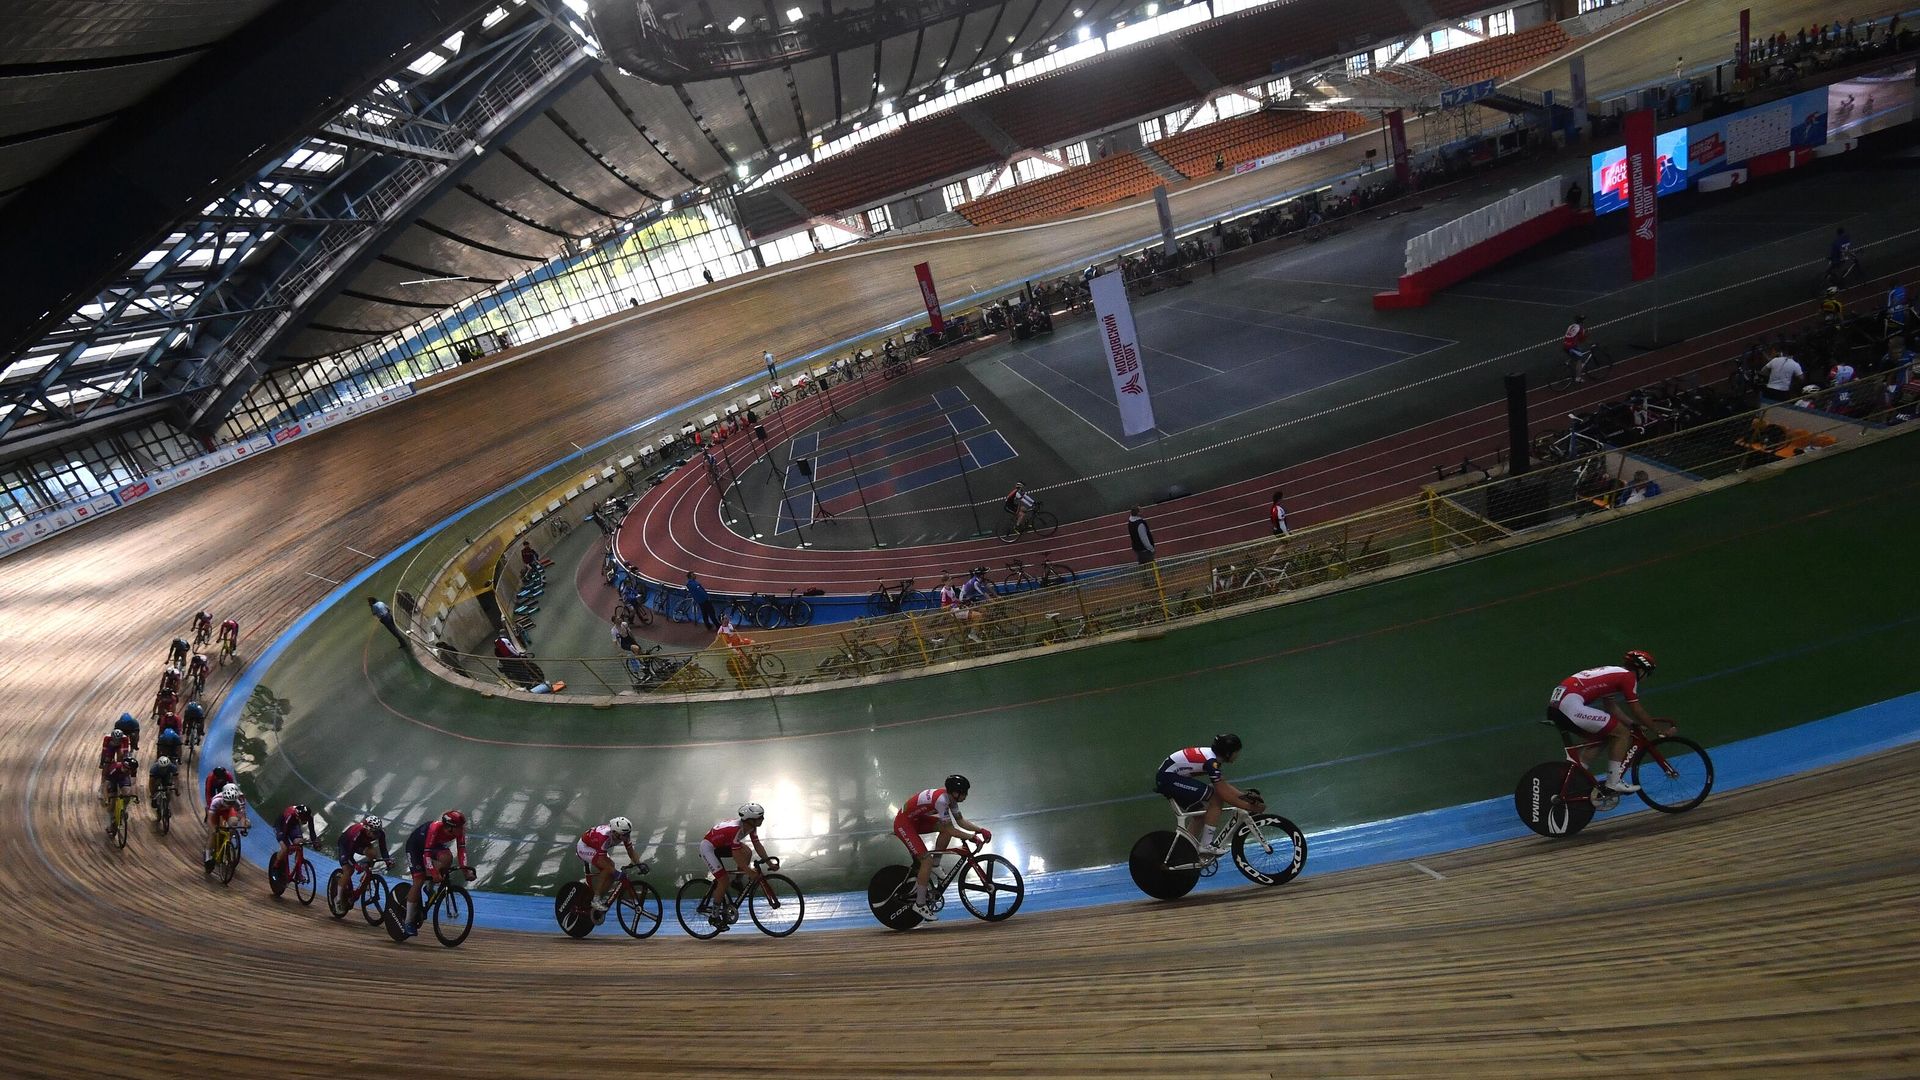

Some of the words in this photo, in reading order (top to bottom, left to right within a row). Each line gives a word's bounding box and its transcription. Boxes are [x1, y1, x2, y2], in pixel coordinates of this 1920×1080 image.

[1789, 150, 1796, 169] 1
[1630, 153, 1644, 218] МОСКОВСКИЙ
[1731, 172, 1740, 188] 2
[1643, 184, 1654, 215] СПОРТ
[1101, 313, 1128, 376] МОСКОВСКИЙ
[1122, 342, 1139, 372] СПОРТ
[1532, 777, 1540, 823] CORIMA
[1213, 814, 1239, 849] RIDLEY
[558, 886, 577, 913] CORIMA
